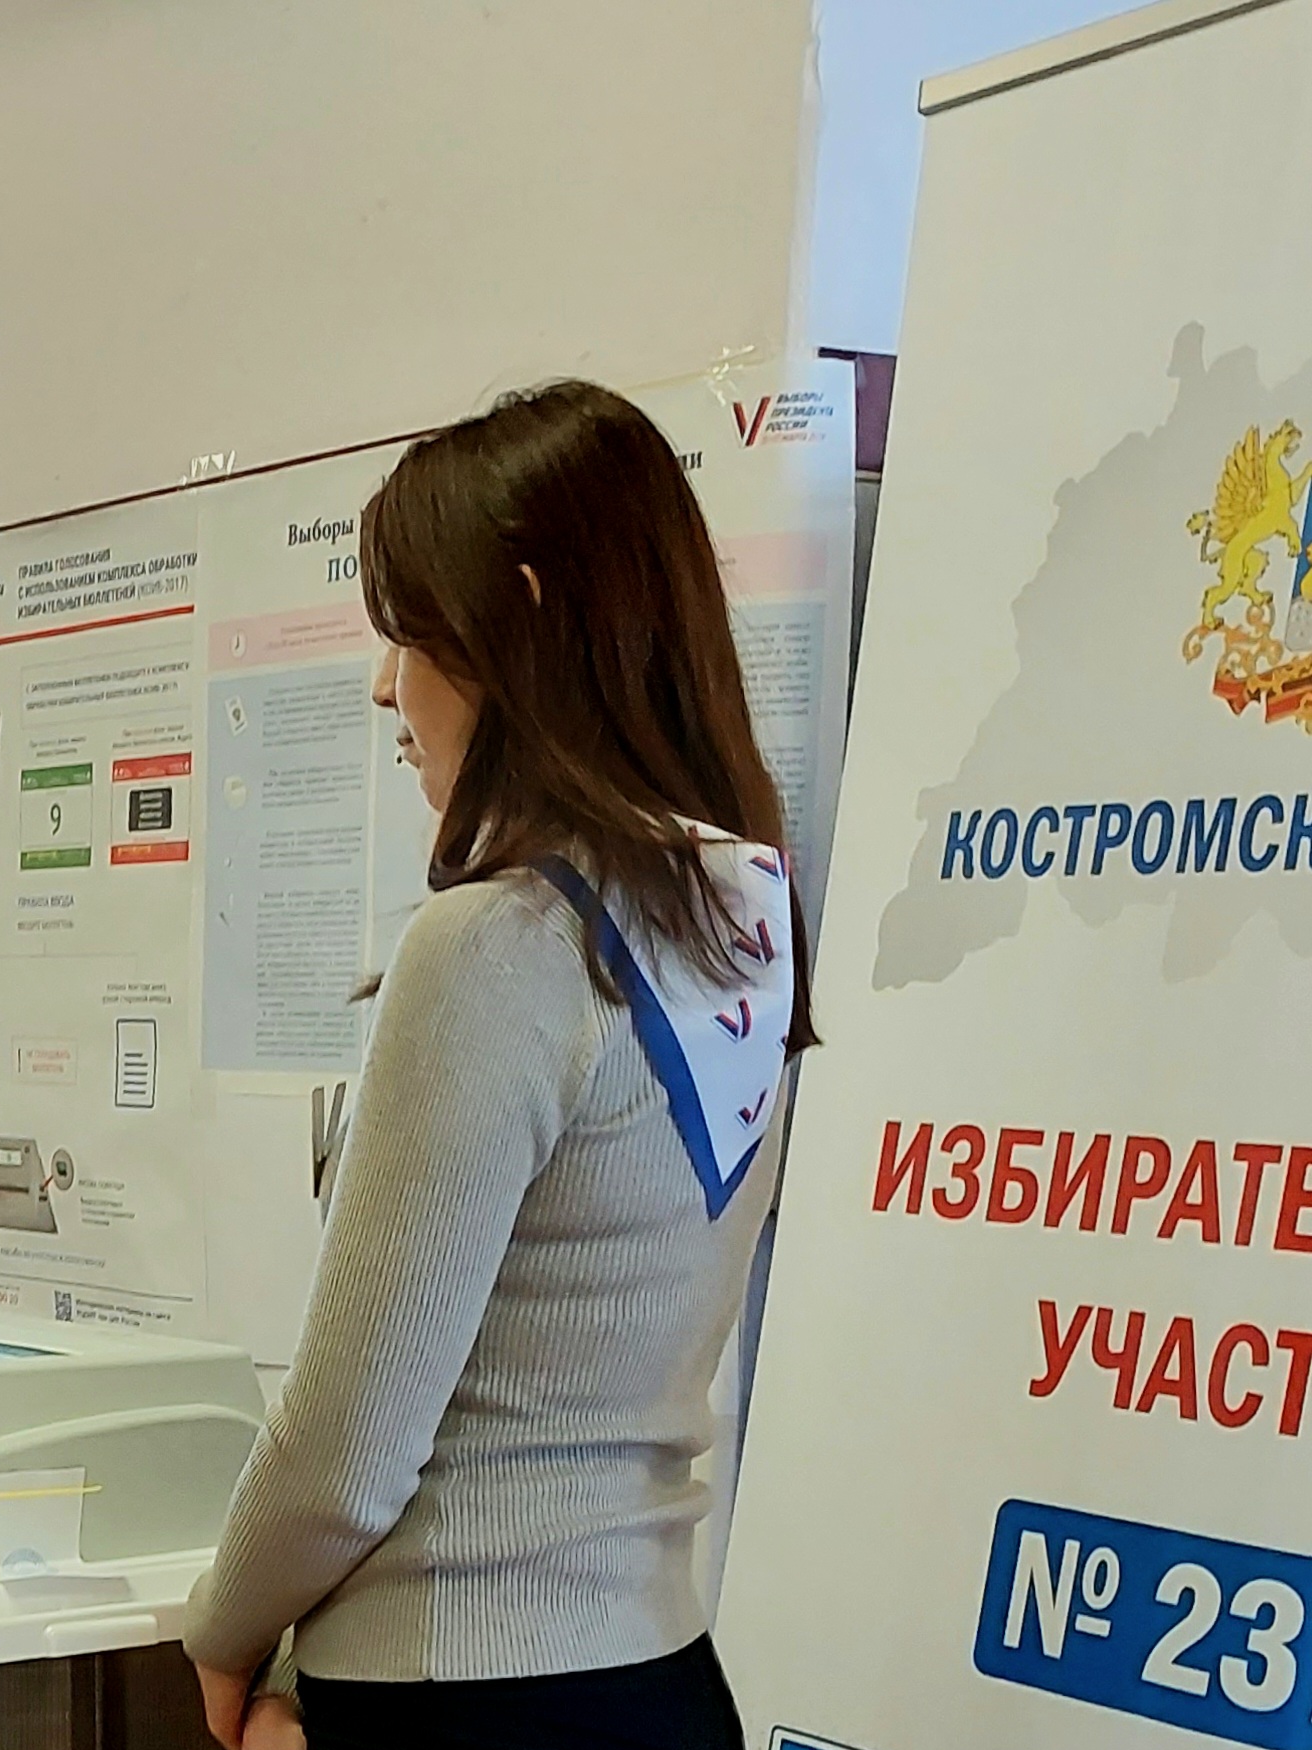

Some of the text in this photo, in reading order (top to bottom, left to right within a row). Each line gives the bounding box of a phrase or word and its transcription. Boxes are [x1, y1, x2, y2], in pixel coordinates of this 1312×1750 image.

[287, 517, 354, 546] Выборы
[872, 1120, 1312, 1253] ИЗБИРАТЕ
[1029, 1299, 1312, 1436] УЧАСТ
[1003, 1529, 1305, 1712] № 23
